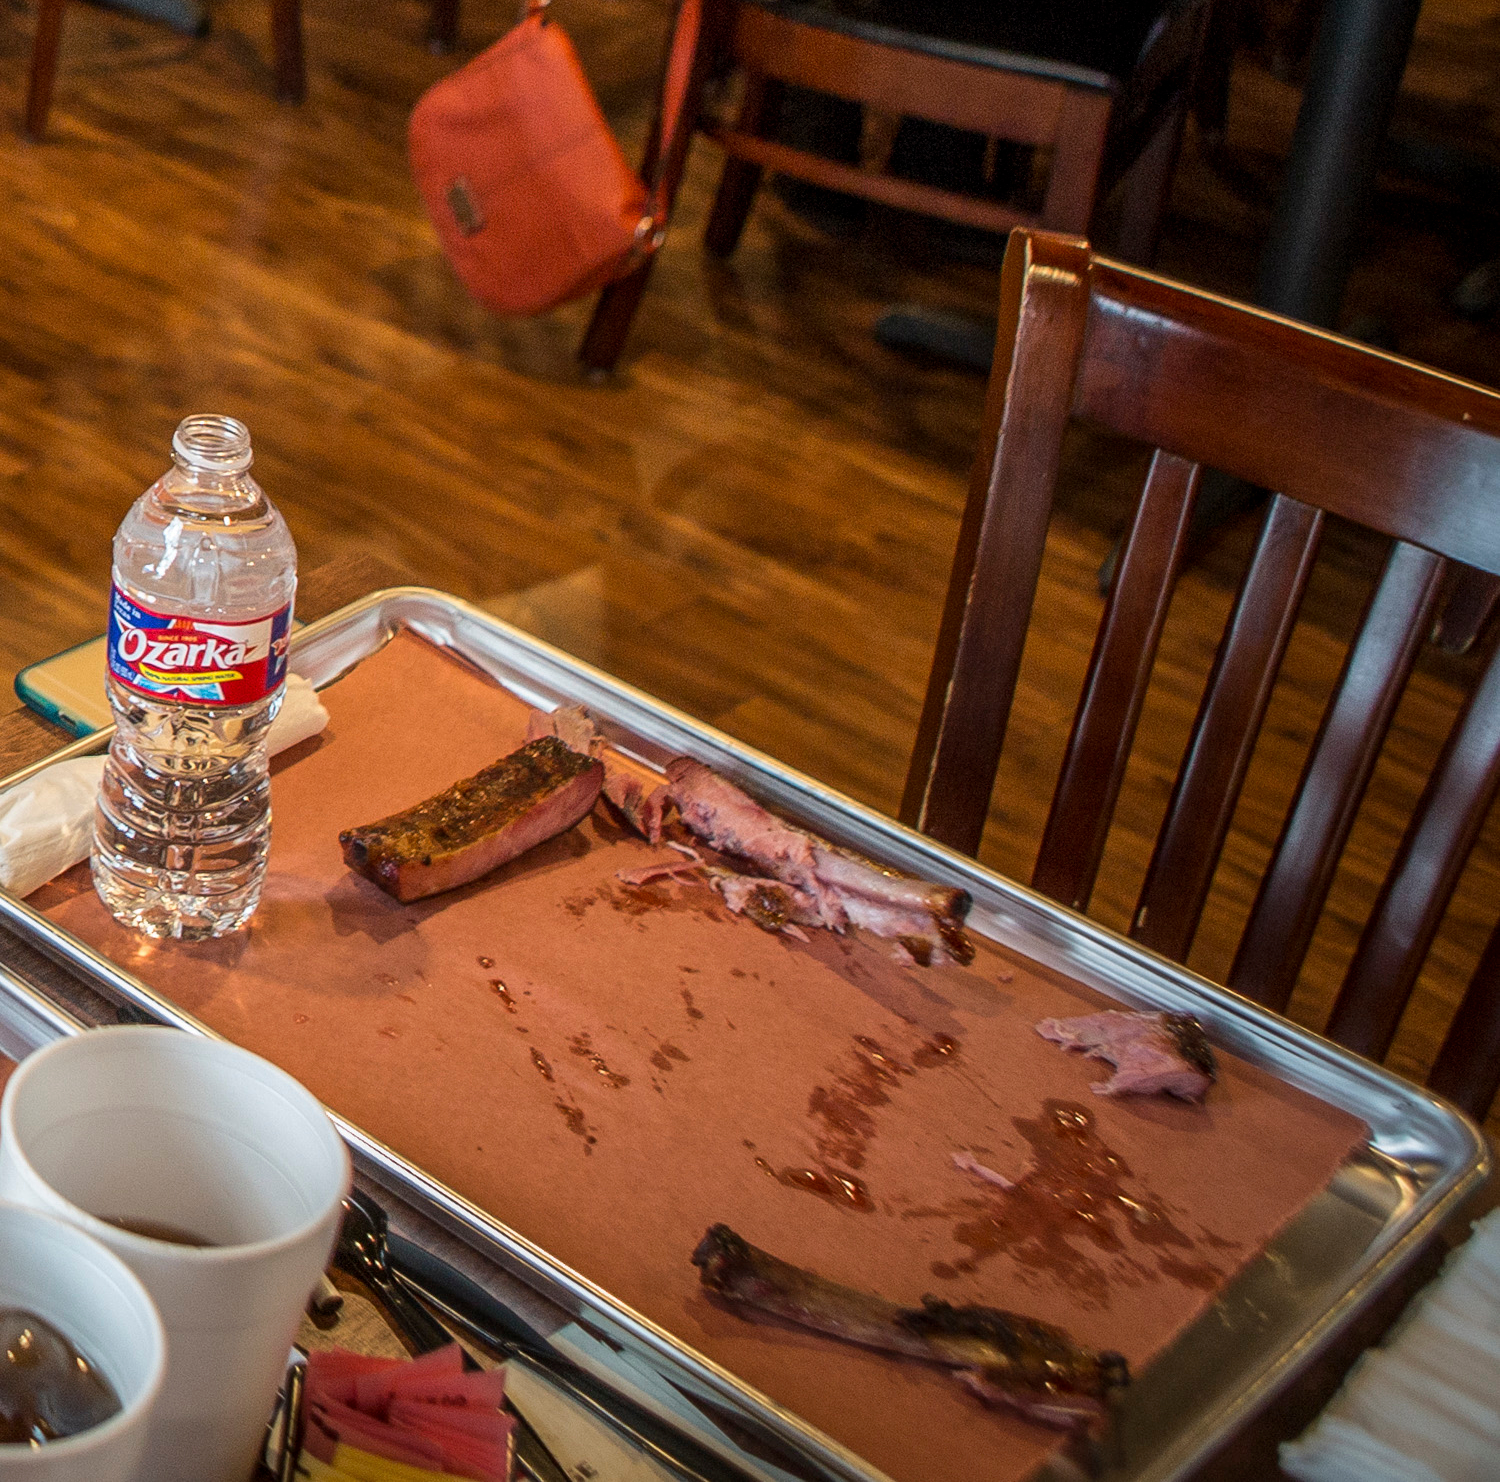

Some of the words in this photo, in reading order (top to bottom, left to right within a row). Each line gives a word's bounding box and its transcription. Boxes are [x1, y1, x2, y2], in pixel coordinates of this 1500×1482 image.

[157, 634, 179, 642] SINCE
[117, 628, 246, 670] Ozarka
[191, 674, 213, 682] SPRING
